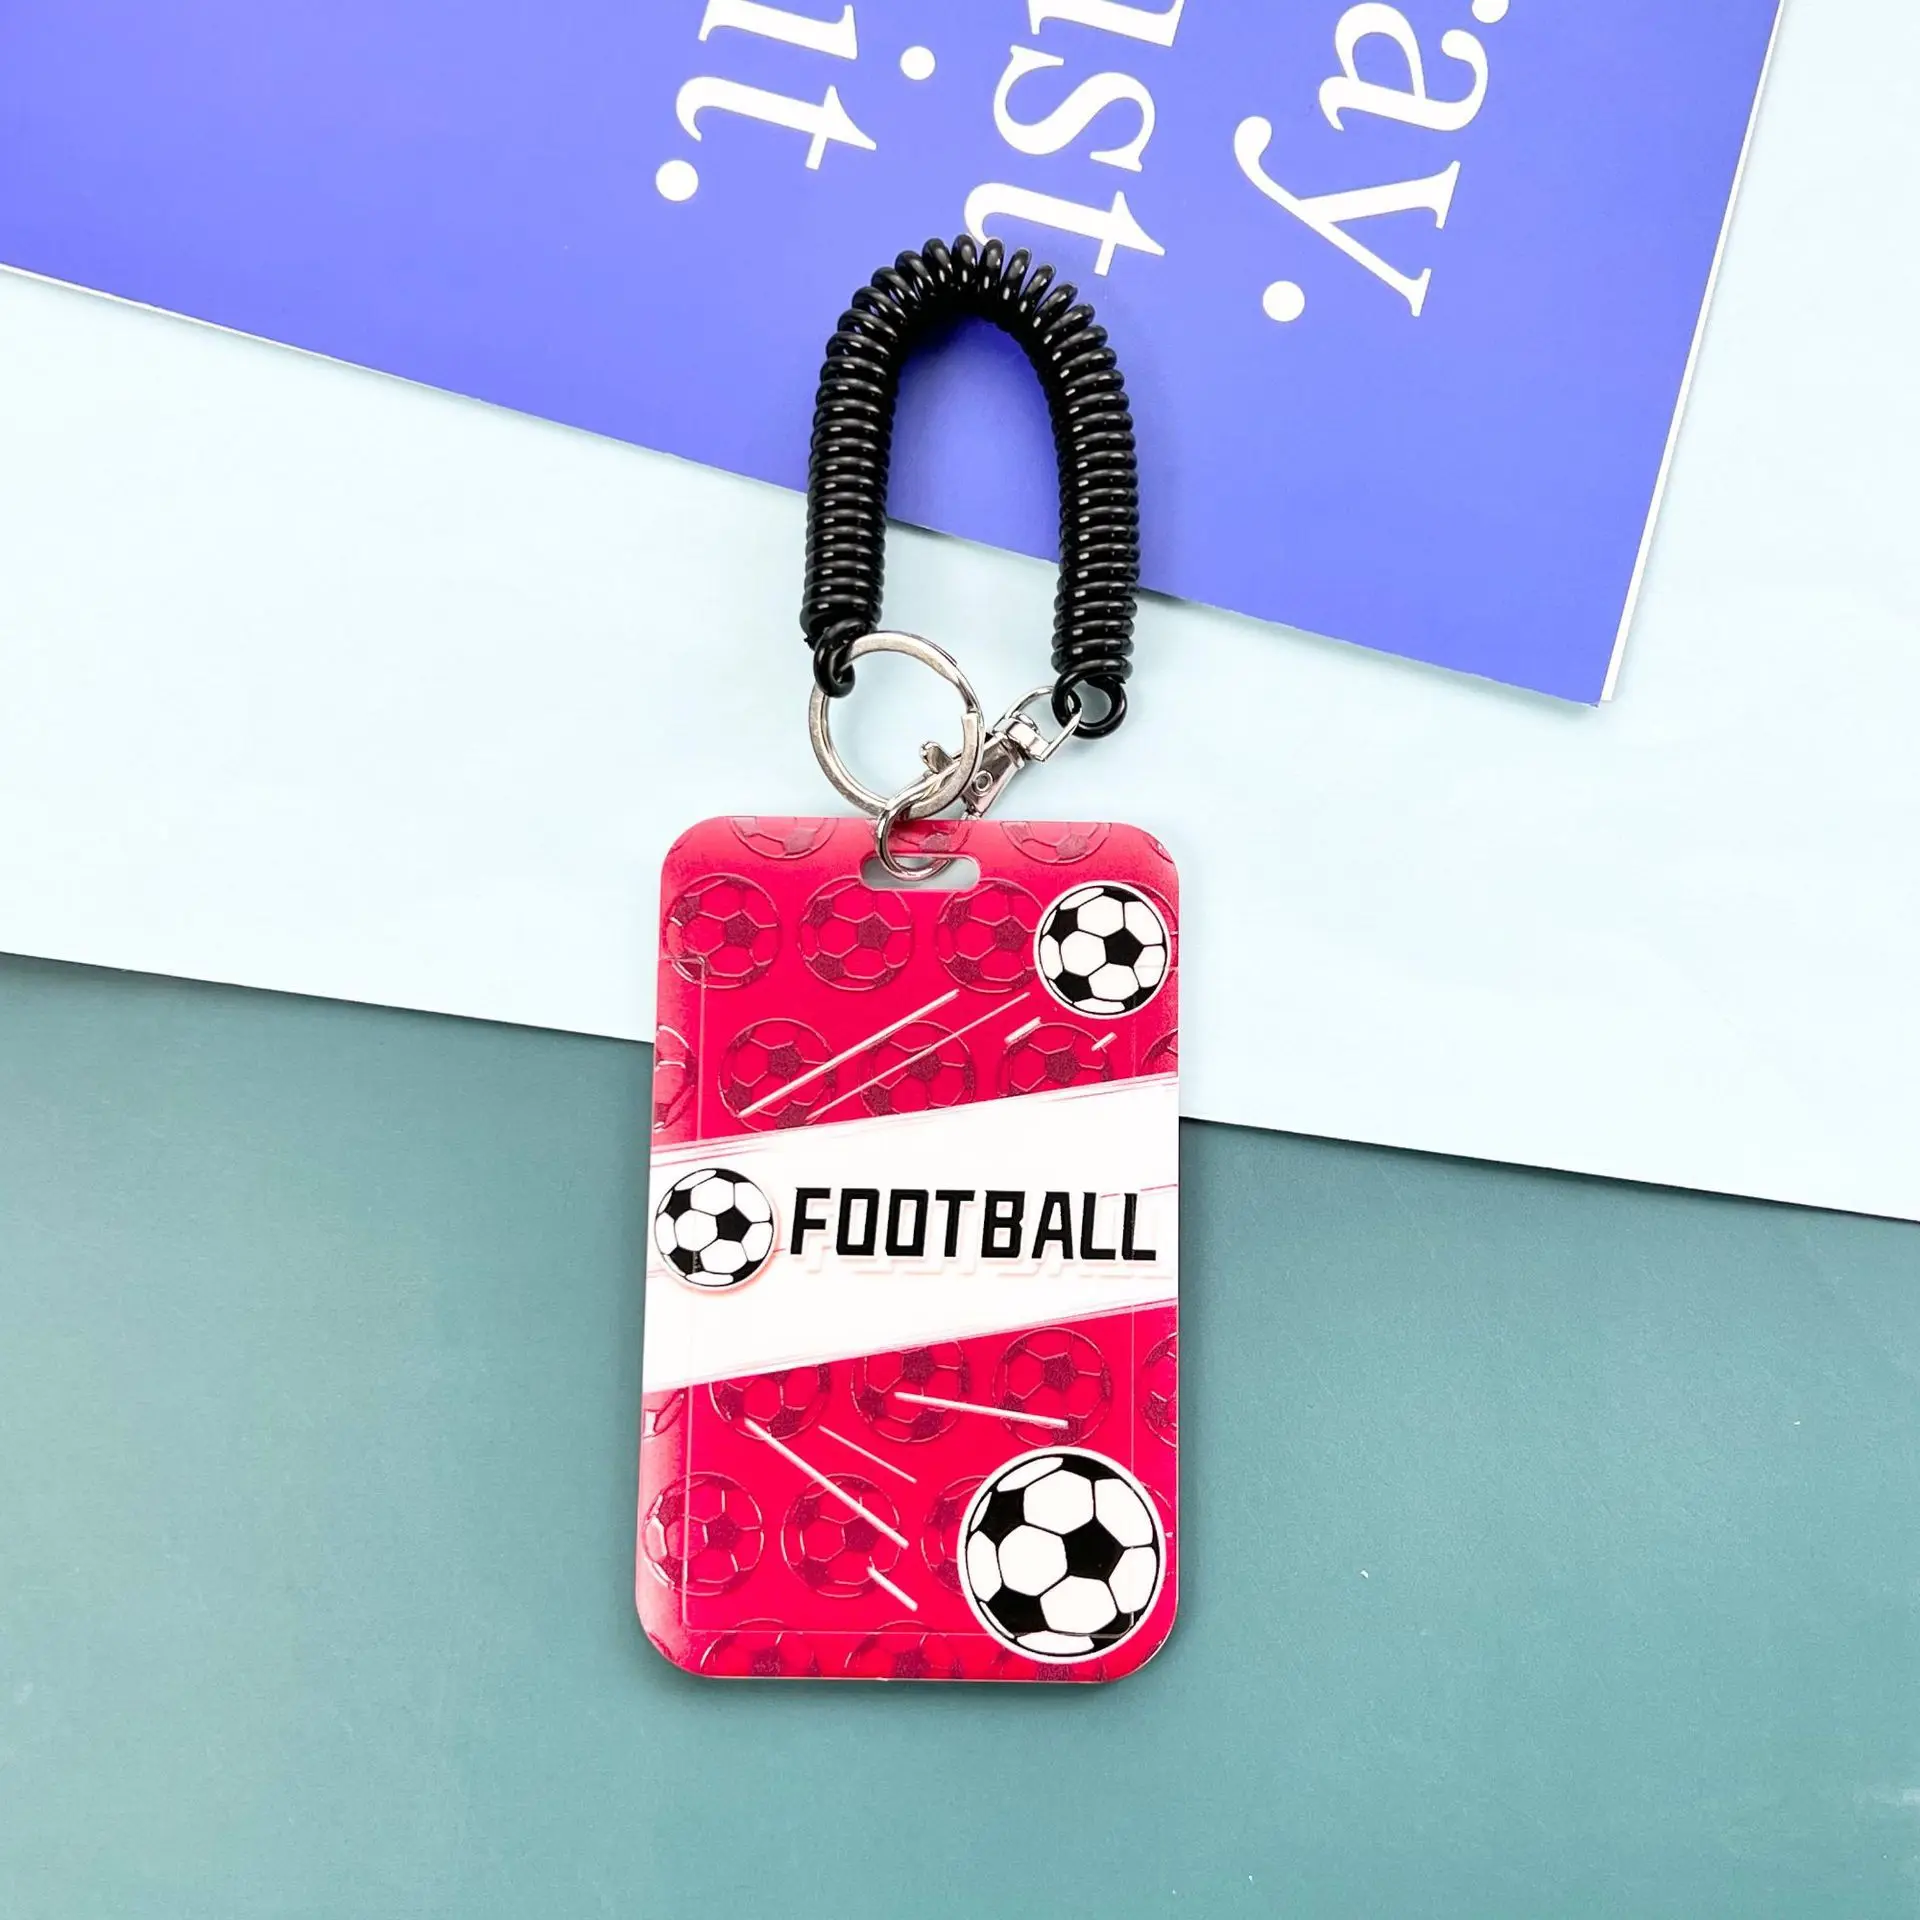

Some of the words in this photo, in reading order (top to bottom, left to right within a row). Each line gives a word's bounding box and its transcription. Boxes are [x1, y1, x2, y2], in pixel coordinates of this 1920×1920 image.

[655, 0, 936, 202] it.
[1233, 0, 1511, 323] ay.
[789, 1187, 1158, 1261] FOOTBALL
